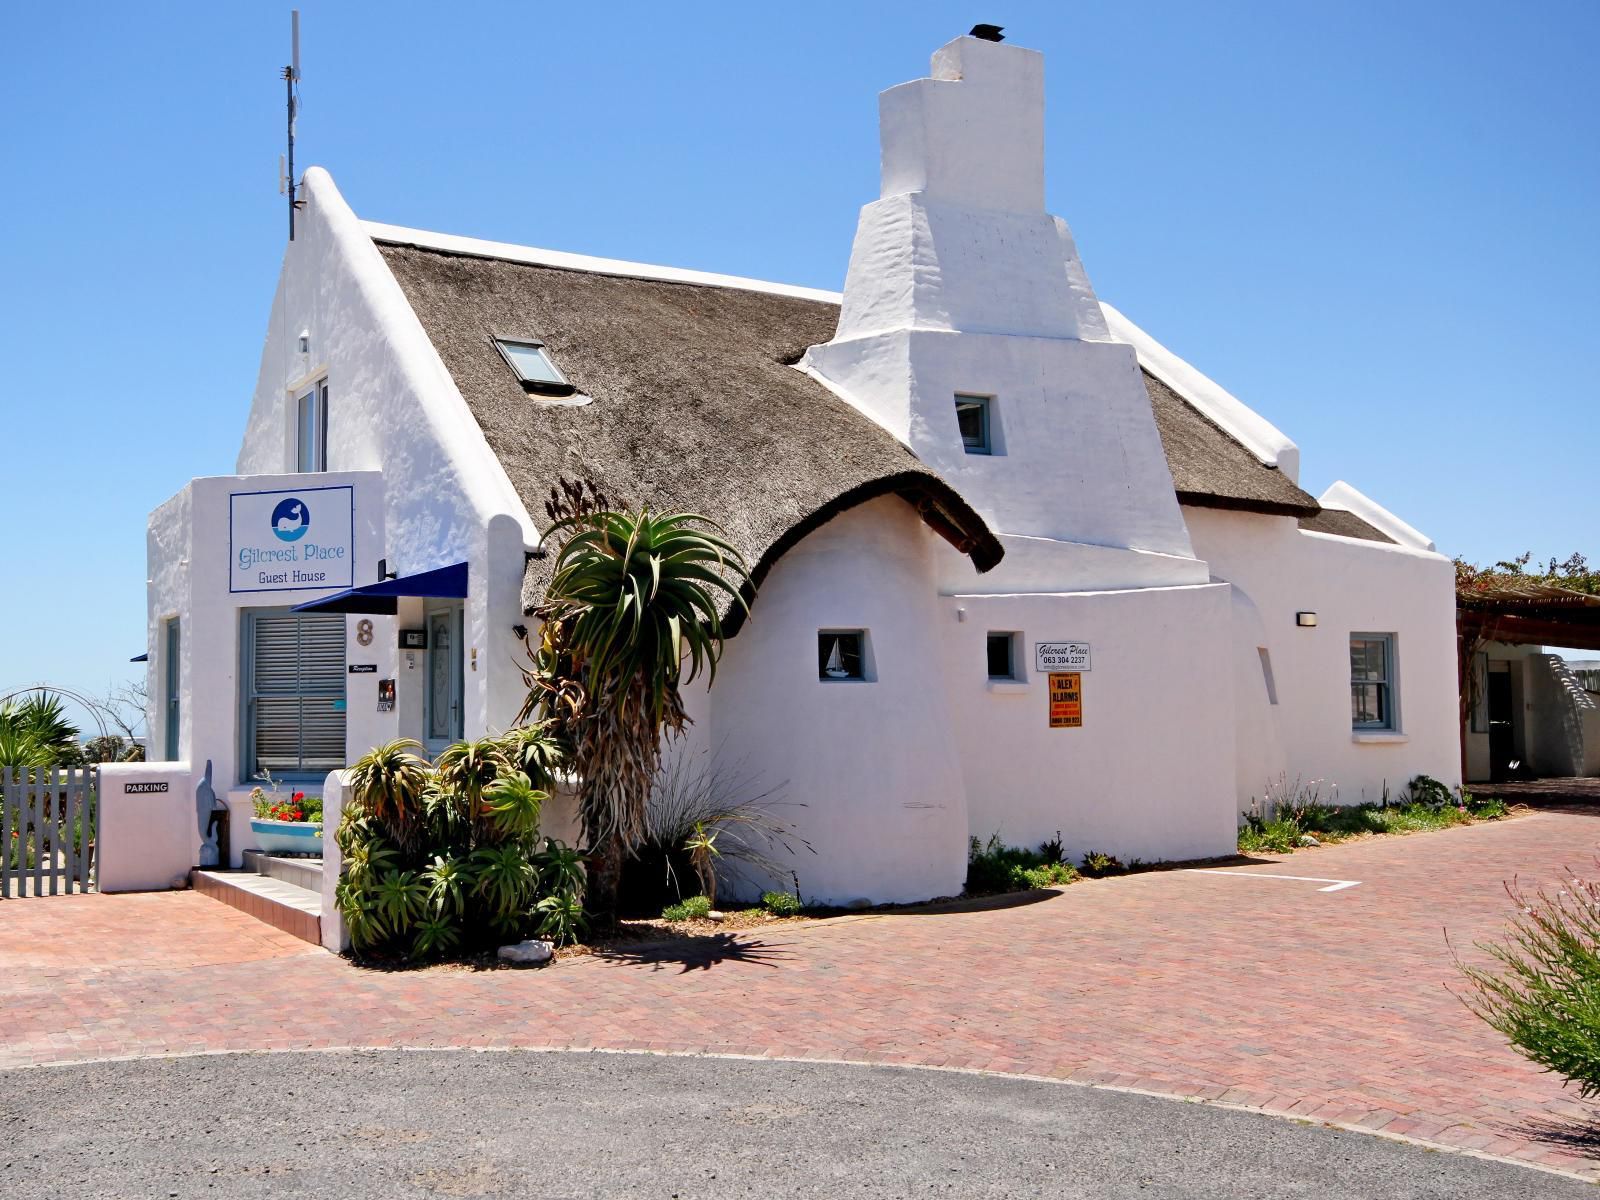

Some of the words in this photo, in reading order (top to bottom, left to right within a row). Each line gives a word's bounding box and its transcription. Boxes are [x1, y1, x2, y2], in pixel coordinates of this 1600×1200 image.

[239, 546, 298, 570] Gilcrest
[304, 544, 344, 560] Place
[259, 572, 288, 583] Guest
[293, 571, 326, 582] House
[357, 619, 373, 647] 8
[1039, 645, 1067, 657] Gilcrest
[1069, 645, 1088, 655] Place
[1056, 680, 1072, 690] ALEX
[126, 784, 168, 792] PARKING
